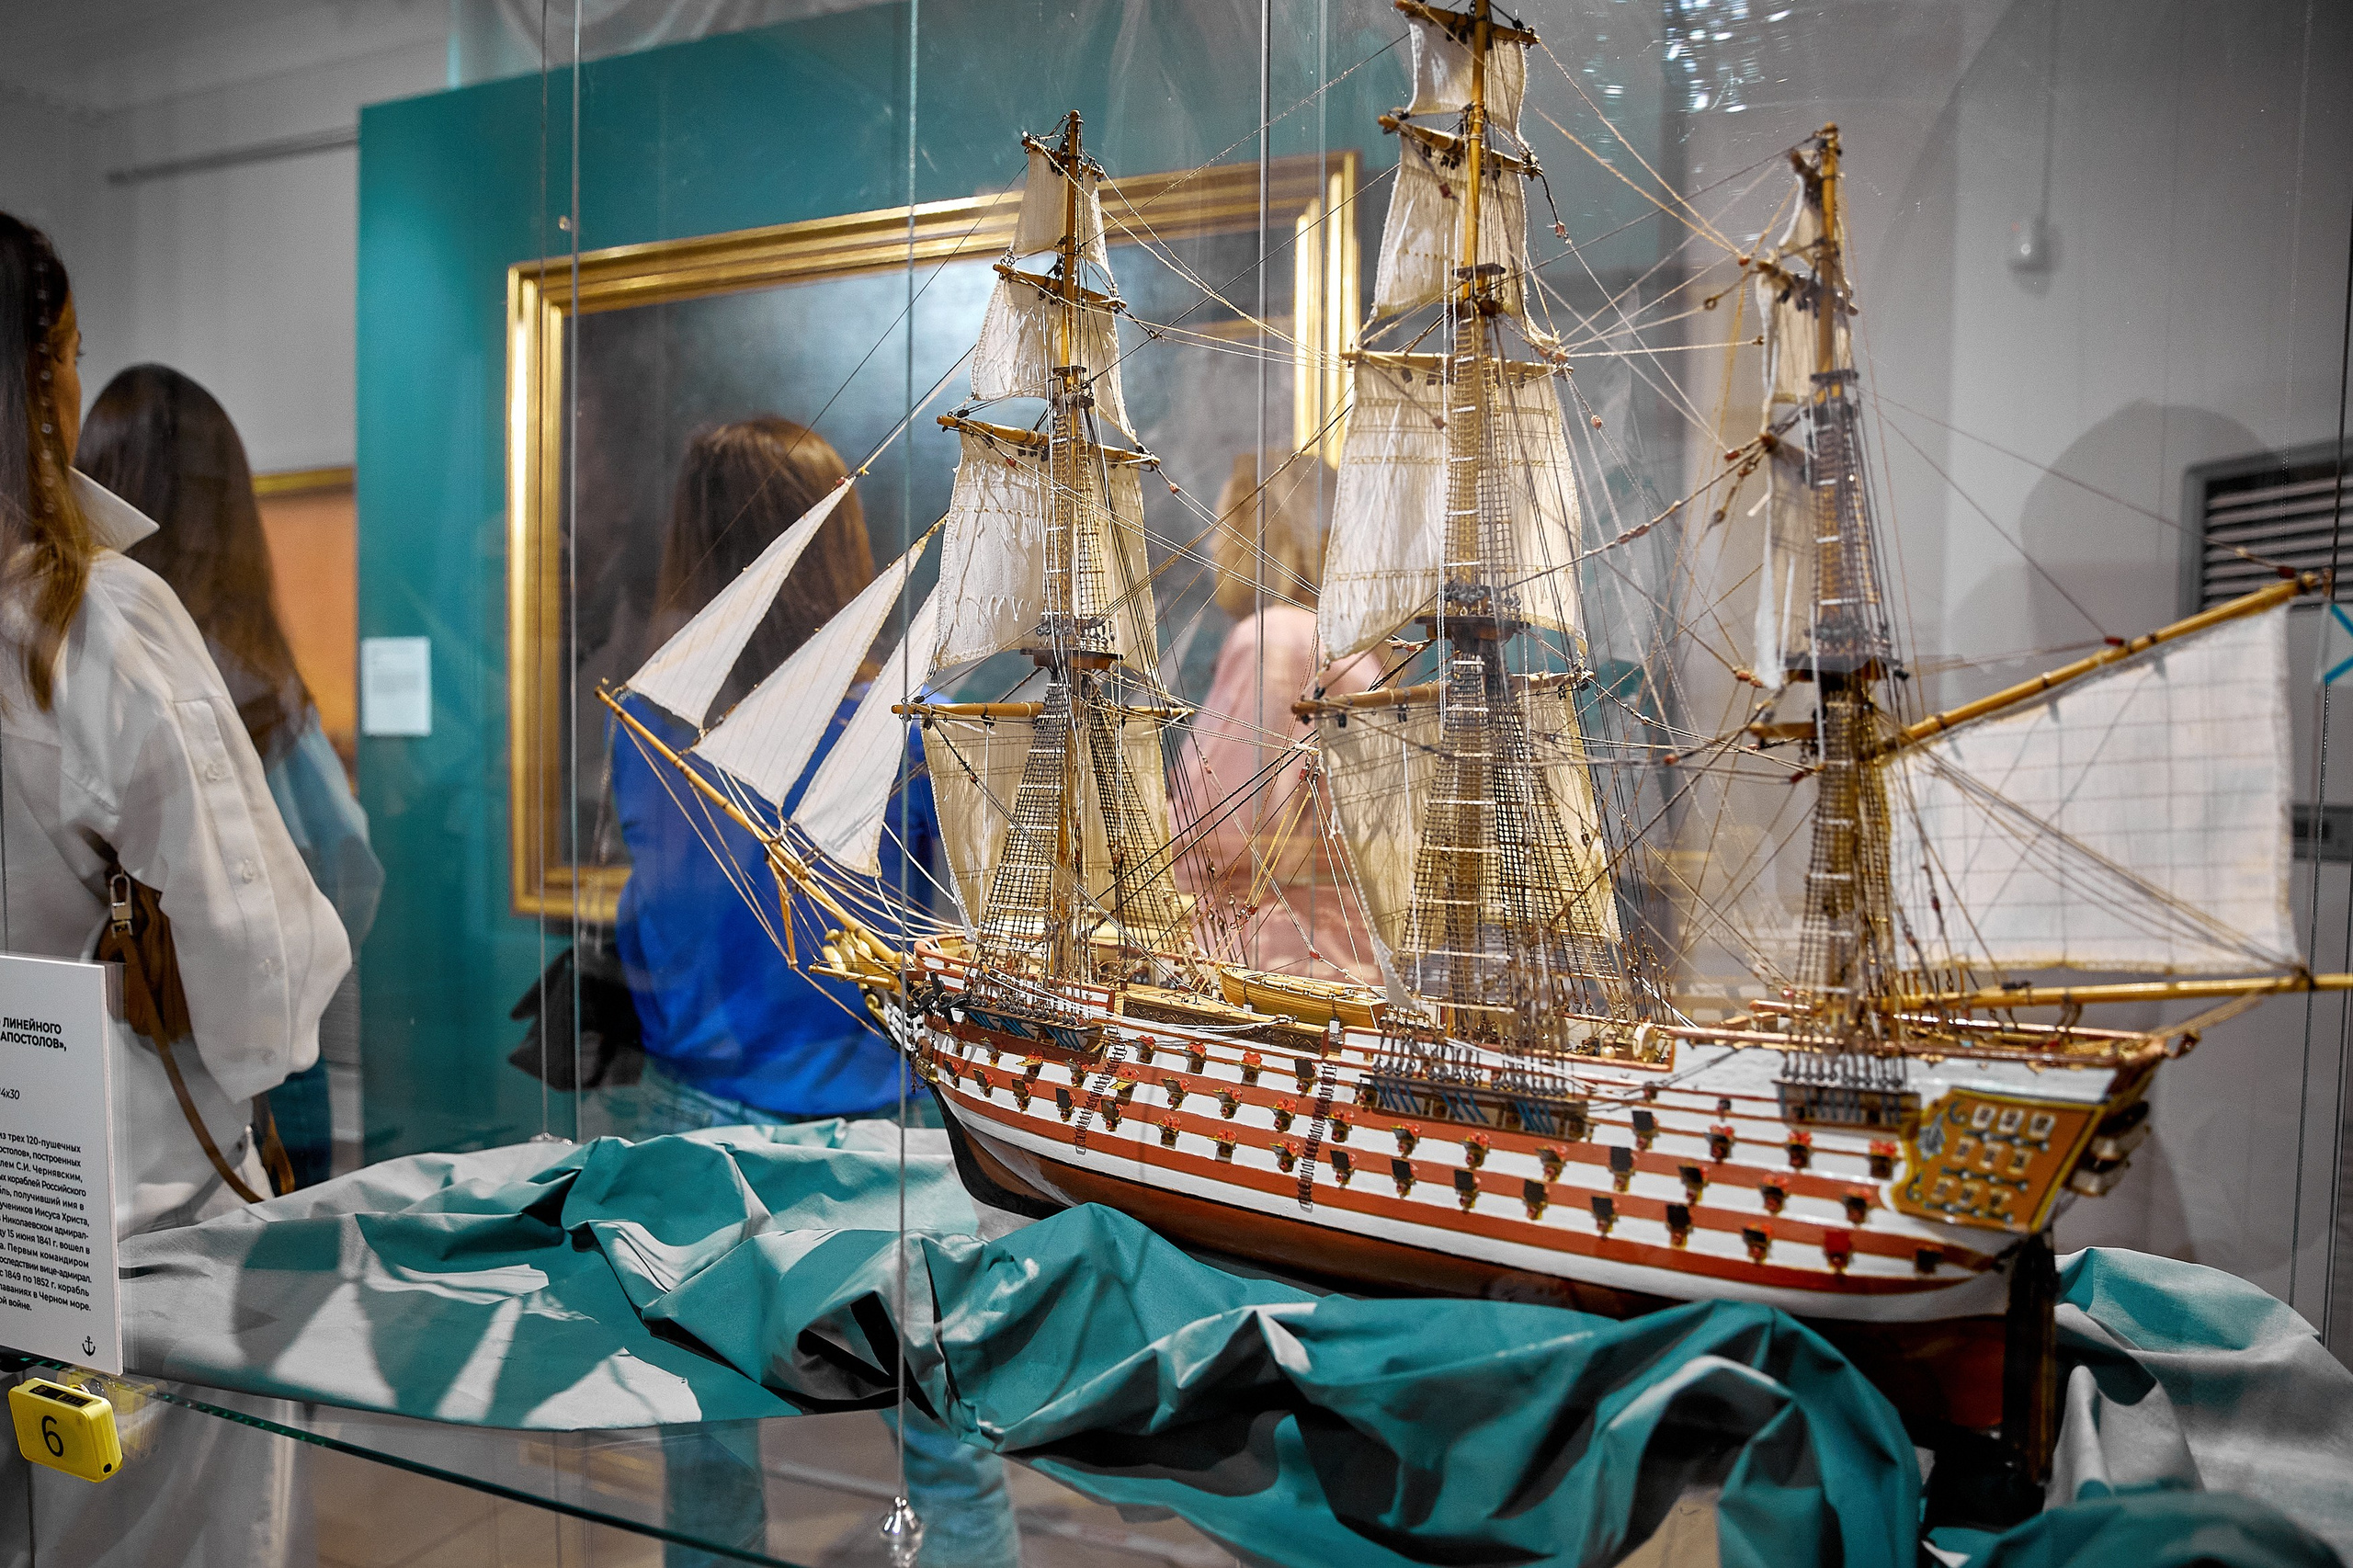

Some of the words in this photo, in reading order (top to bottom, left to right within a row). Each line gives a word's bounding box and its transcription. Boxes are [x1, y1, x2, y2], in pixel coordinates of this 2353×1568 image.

[3, 1017, 62, 1035] ЛИНЕЙНОГО
[0, 1031, 67, 1051] АПОСТОЛОВ»,
[8, 1133, 25, 1143] трех
[27, 1134, 81, 1153] 120-пушечных
[32, 1152, 81, 1167] построенных
[16, 1162, 31, 1172] С.И.
[32, 1165, 83, 1183] Чернявским,
[7, 1175, 40, 1188] кораблей
[41, 1180, 86, 1197] Российского
[0, 1186, 12, 1198] ль,
[14, 1190, 61, 1206] получивший
[63, 1200, 77, 1210] имя
[2, 1214, 53, 1233] Николаевском
[54, 1226, 88, 1240] адмирал-
[34, 1207, 61, 1221] Иисуса
[62, 1212, 90, 1227] Христа,
[7, 1228, 15, 1238] 15
[16, 1232, 36, 1243] июня
[37, 1234, 51, 1246] 1841
[60, 1242, 84, 1253] вошел
[7, 1243, 38, 1257] Первым
[40, 1251, 89, 1268] командиром
[5, 1269, 21, 1280] 1849
[23, 1275, 32, 1284] по
[33, 1276, 50, 1288] 1852
[51, 1281, 56, 1290] г.
[57, 1283, 90, 1297] корабль
[40, 1265, 92, 1283] вице-адмирал.
[8, 1298, 32, 1312] войне.
[39, 1290, 68, 1306] Черном
[70, 1300, 92, 1312] море.
[41, 1415, 64, 1458] 6
